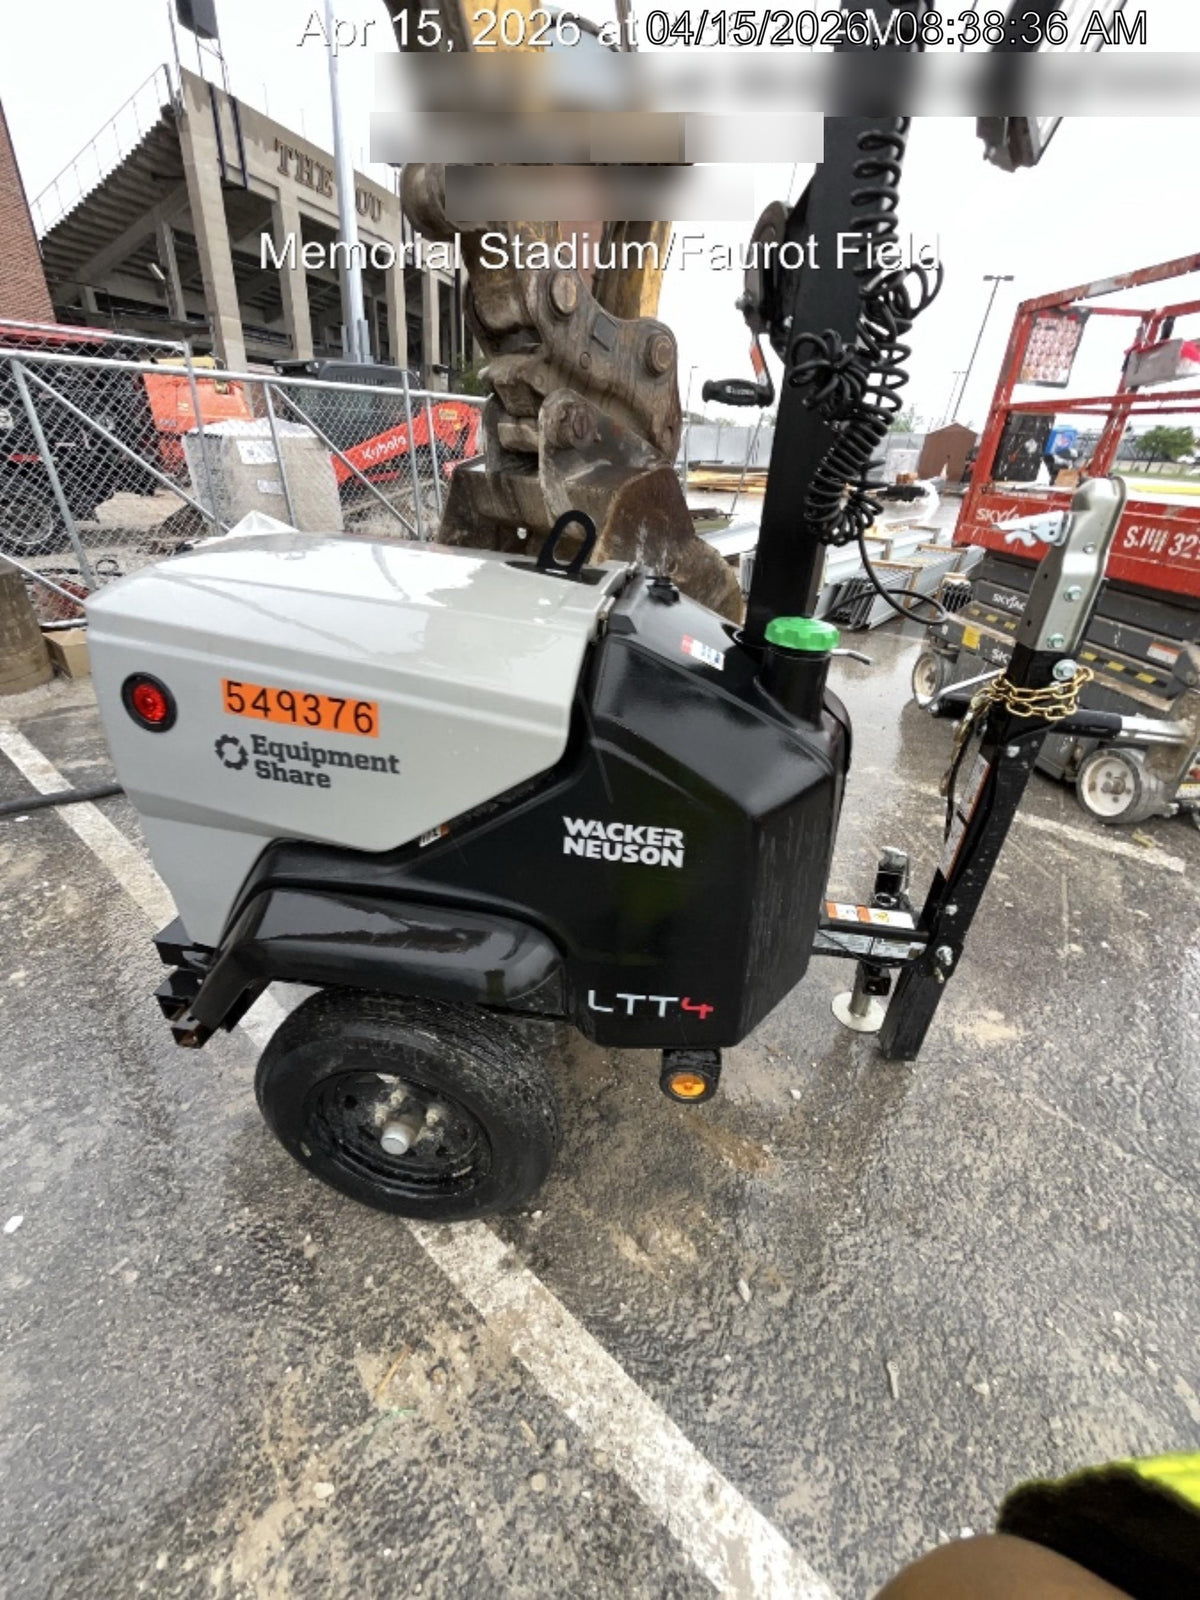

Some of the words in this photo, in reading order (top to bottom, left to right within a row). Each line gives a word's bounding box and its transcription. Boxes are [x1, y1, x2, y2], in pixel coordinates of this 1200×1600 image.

[275, 137, 334, 200] THE
[349, 182, 382, 223] OU
[362, 434, 407, 461] Kubota
[226, 679, 374, 735] 549376
[250, 733, 401, 775] Equipment
[254, 759, 332, 789] Share
[562, 816, 685, 849] WACKER
[562, 836, 685, 868] NEUSON
[587, 989, 714, 1020] LTT4
